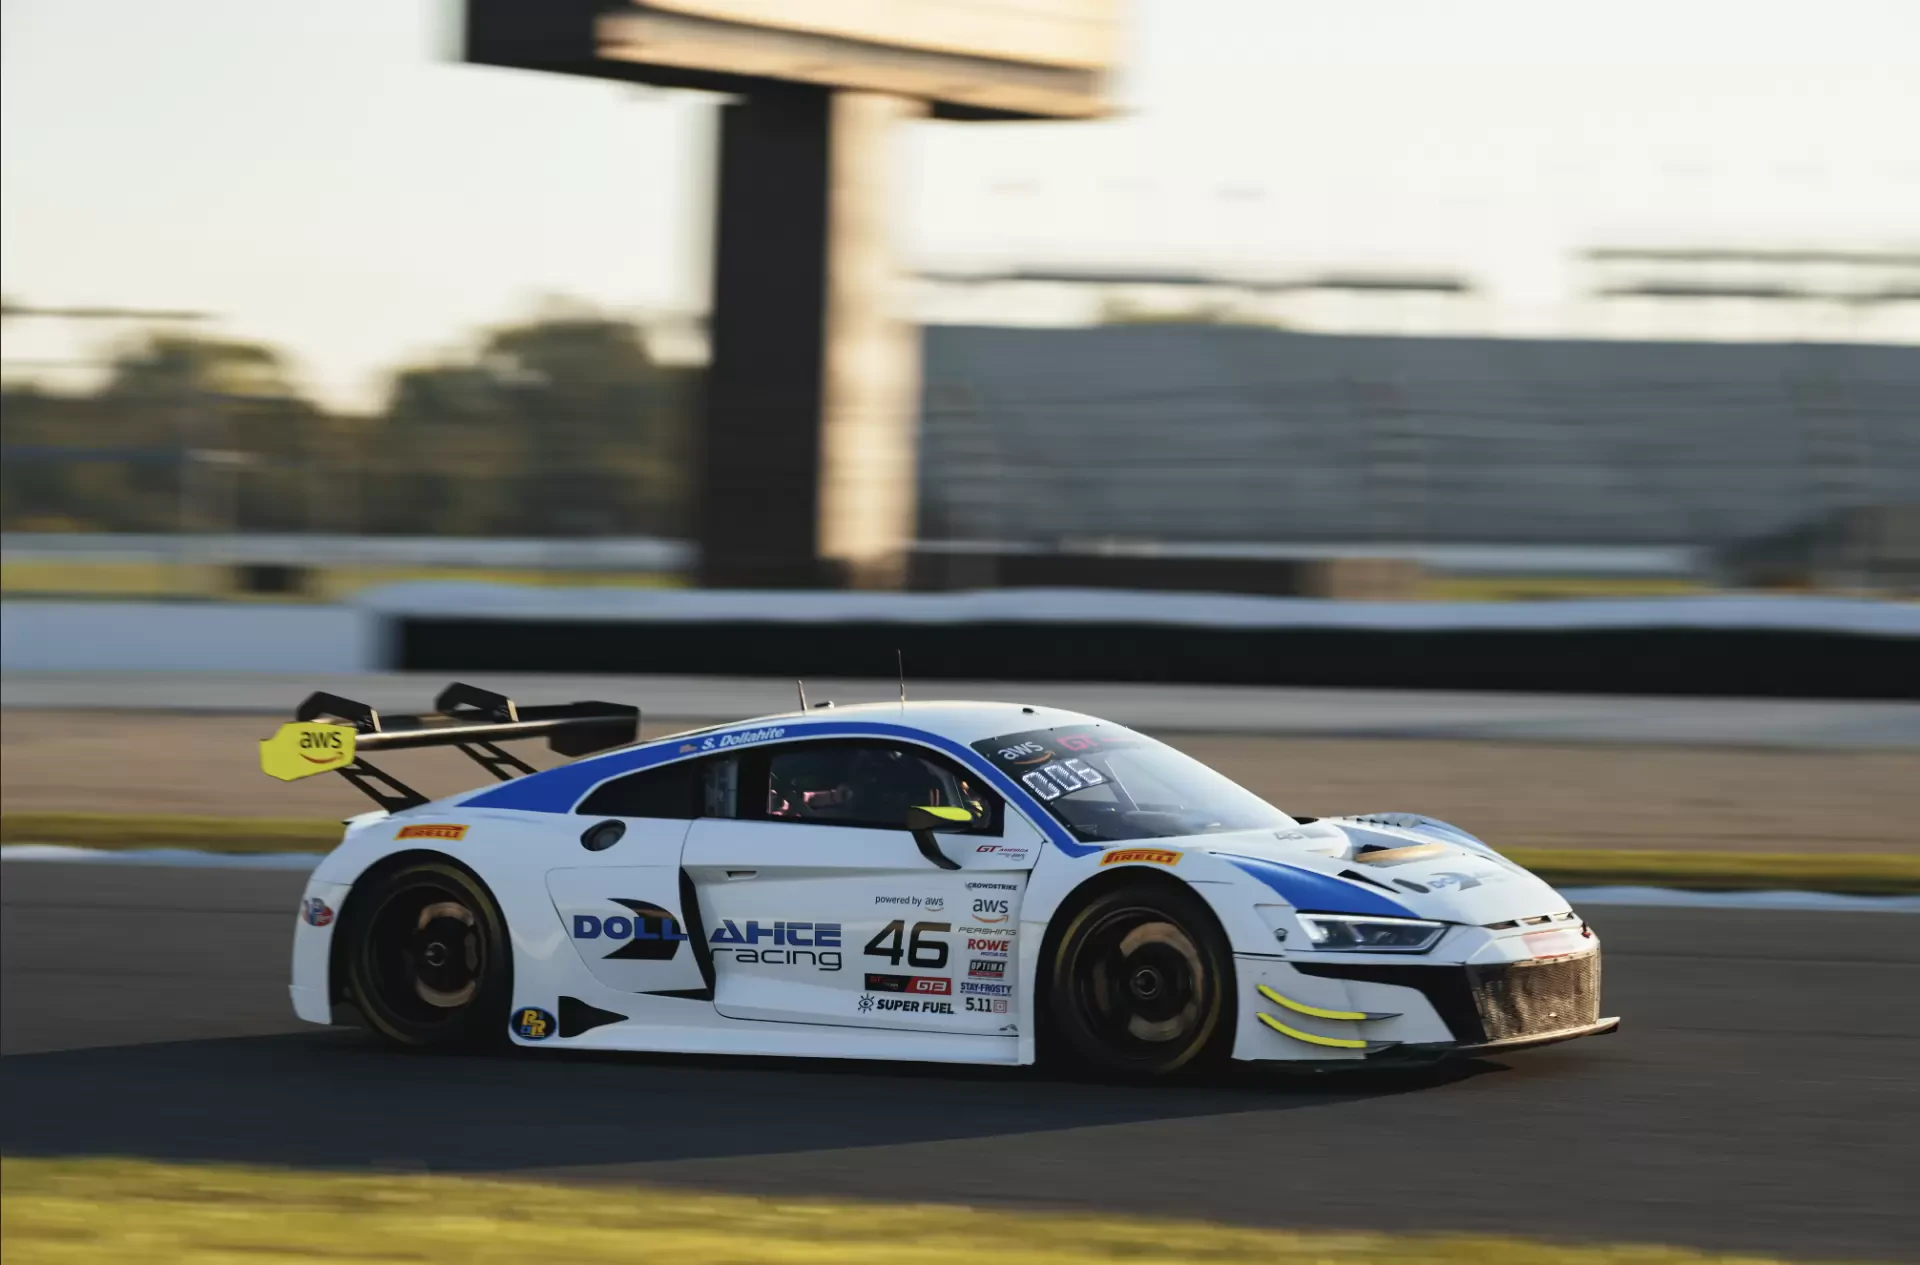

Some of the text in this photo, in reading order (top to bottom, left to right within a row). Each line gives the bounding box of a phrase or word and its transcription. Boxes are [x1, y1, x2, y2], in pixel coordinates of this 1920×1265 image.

[300, 732, 342, 748] aws
[701, 728, 785, 750] S. Dollahite
[998, 741, 1044, 760] aws
[1022, 758, 1103, 801] 006
[1103, 849, 1177, 864] PIRELLI
[967, 882, 1018, 891] CROWDSTRIKE
[875, 895, 944, 907] powered by aws
[973, 898, 1009, 914] aws
[958, 926, 1017, 936] PERSHING
[864, 919, 952, 969] 46
[967, 938, 1010, 952] ROWE
[711, 947, 842, 971] racing
[970, 961, 1004, 972] OPTIMA
[916, 980, 947, 991] GT3
[960, 982, 1013, 994] STAY-FROSTY
[876, 999, 955, 1015] SUPER FUEL
[965, 997, 992, 1013] 5.11
